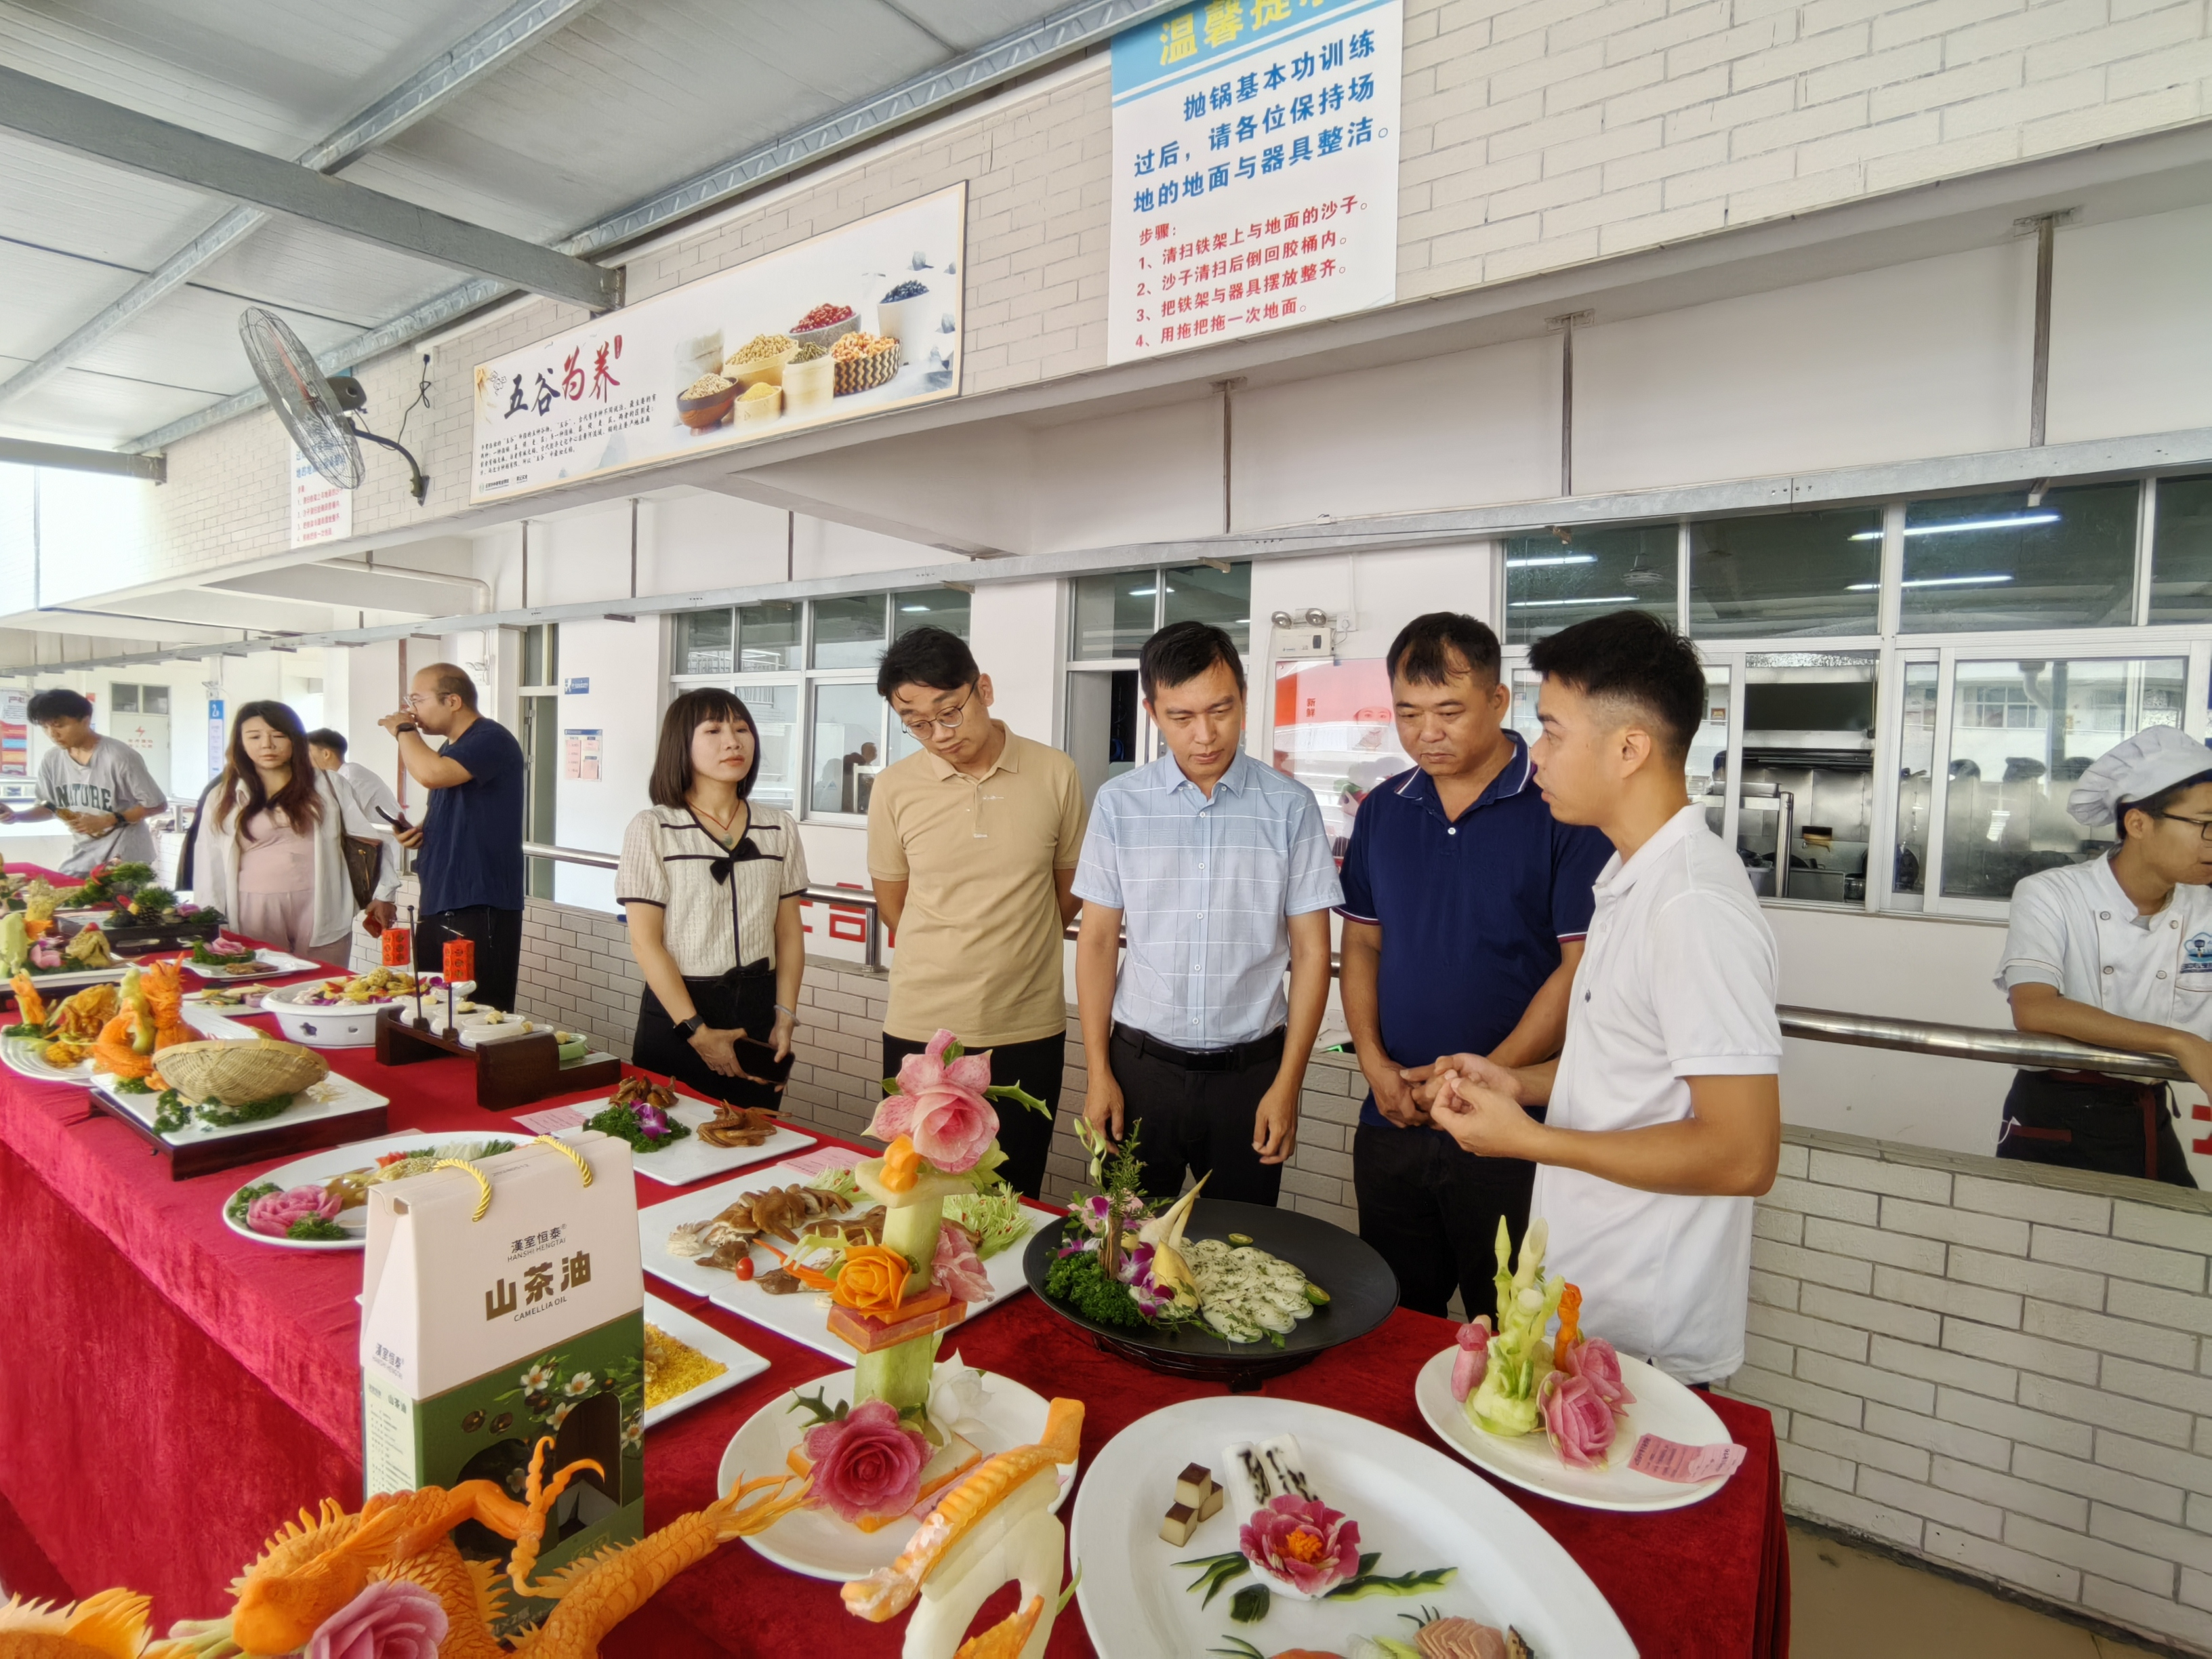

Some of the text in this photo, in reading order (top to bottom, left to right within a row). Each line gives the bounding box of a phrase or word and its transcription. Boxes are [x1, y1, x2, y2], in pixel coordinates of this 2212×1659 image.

[1160, 0, 1325, 66] 温馨提
[1183, 28, 1375, 121] 抛锅基本功训练
[1134, 72, 1374, 178] 过后，请各位保持场
[1132, 116, 1389, 213] 地的地面与器具整洁。
[485, 1250, 591, 1322] 山茶油
[508, 1237, 566, 1263] HANSHI HENGTAI
[514, 1296, 567, 1322] CAMELLIA OIL
